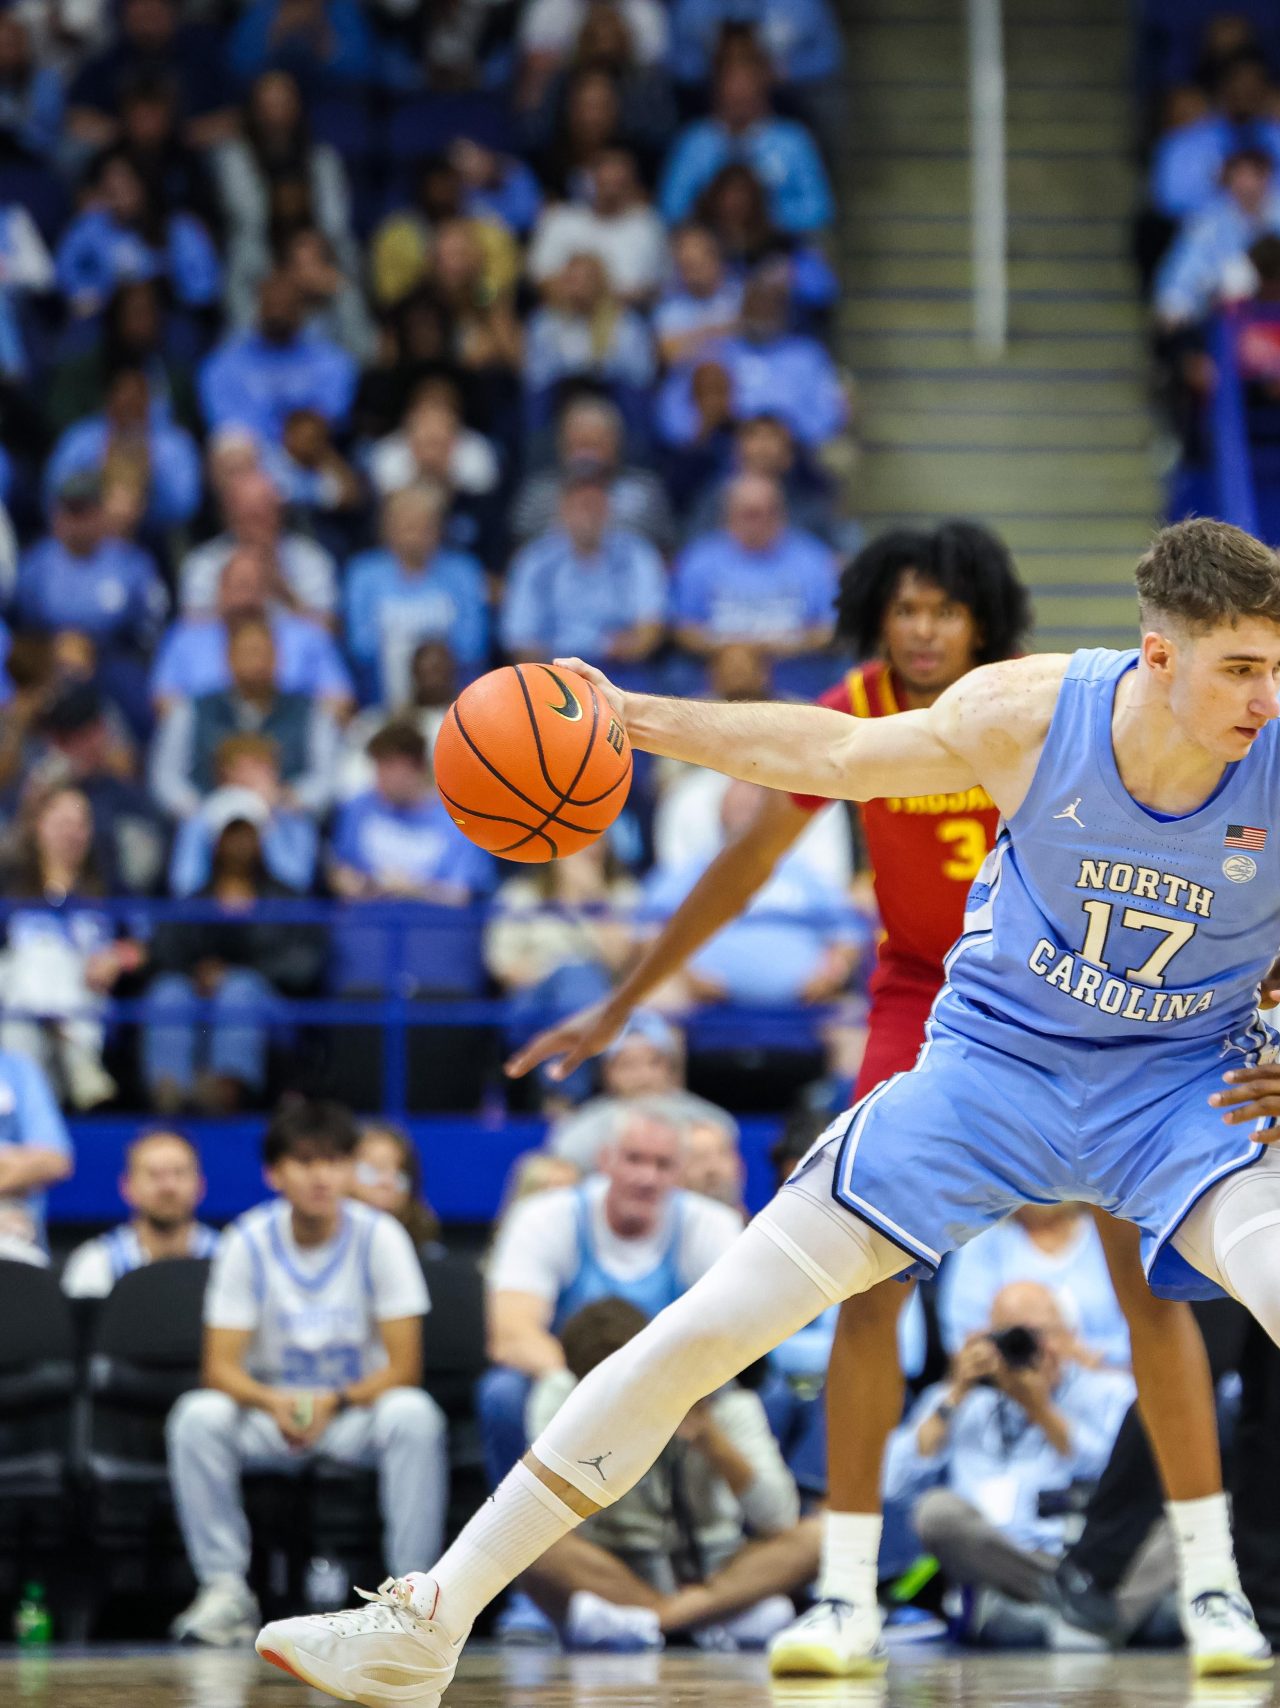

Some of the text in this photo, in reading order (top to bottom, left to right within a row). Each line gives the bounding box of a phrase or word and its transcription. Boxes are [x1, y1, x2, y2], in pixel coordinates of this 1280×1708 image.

[936, 817, 986, 881] 3
[1075, 859, 1215, 918] NORTH
[1028, 937, 1216, 1022] CAROLINA
[1073, 899, 1198, 989] 17
